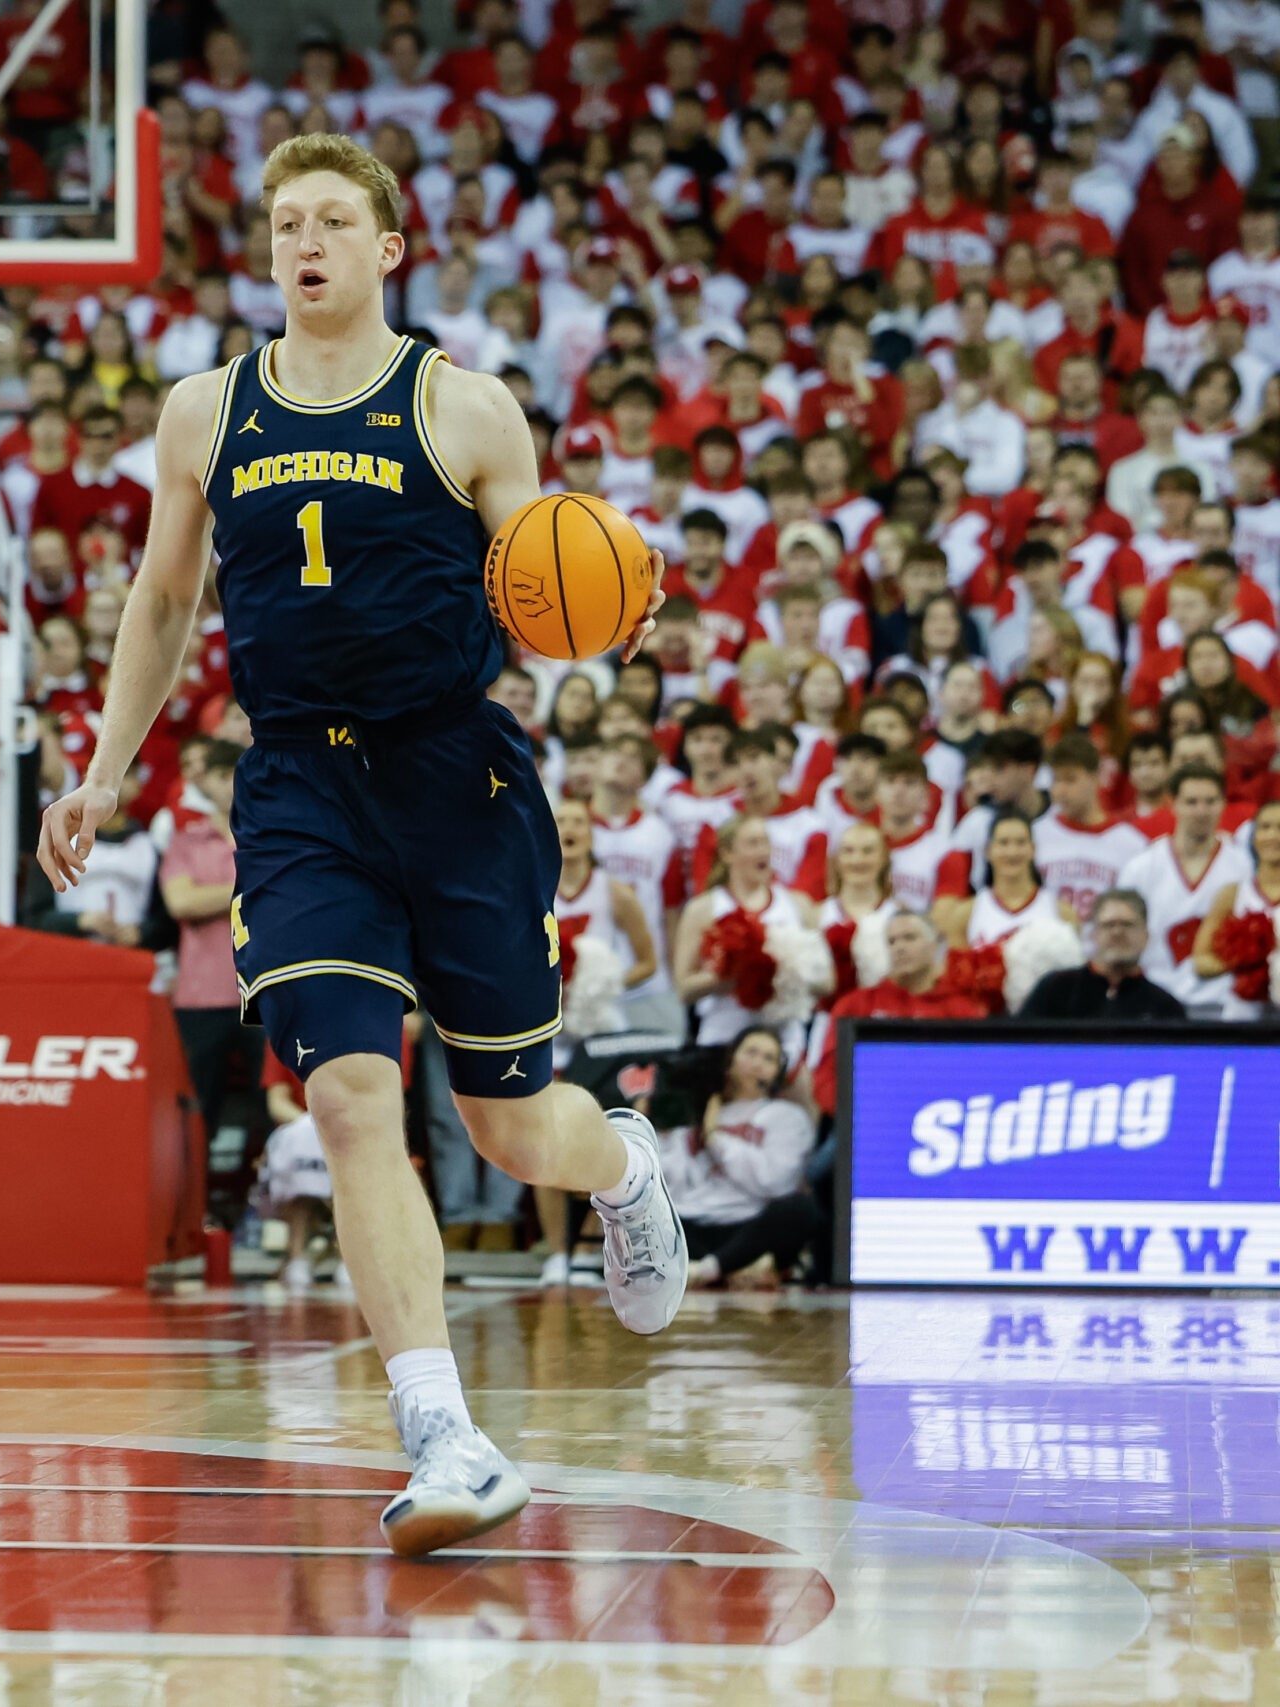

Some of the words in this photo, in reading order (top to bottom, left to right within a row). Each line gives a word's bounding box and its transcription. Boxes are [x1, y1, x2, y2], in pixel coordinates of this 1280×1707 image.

[231, 450, 404, 499] MICHIGAN
[296, 500, 332, 587] 1
[908, 1073, 1176, 1177] Siding
